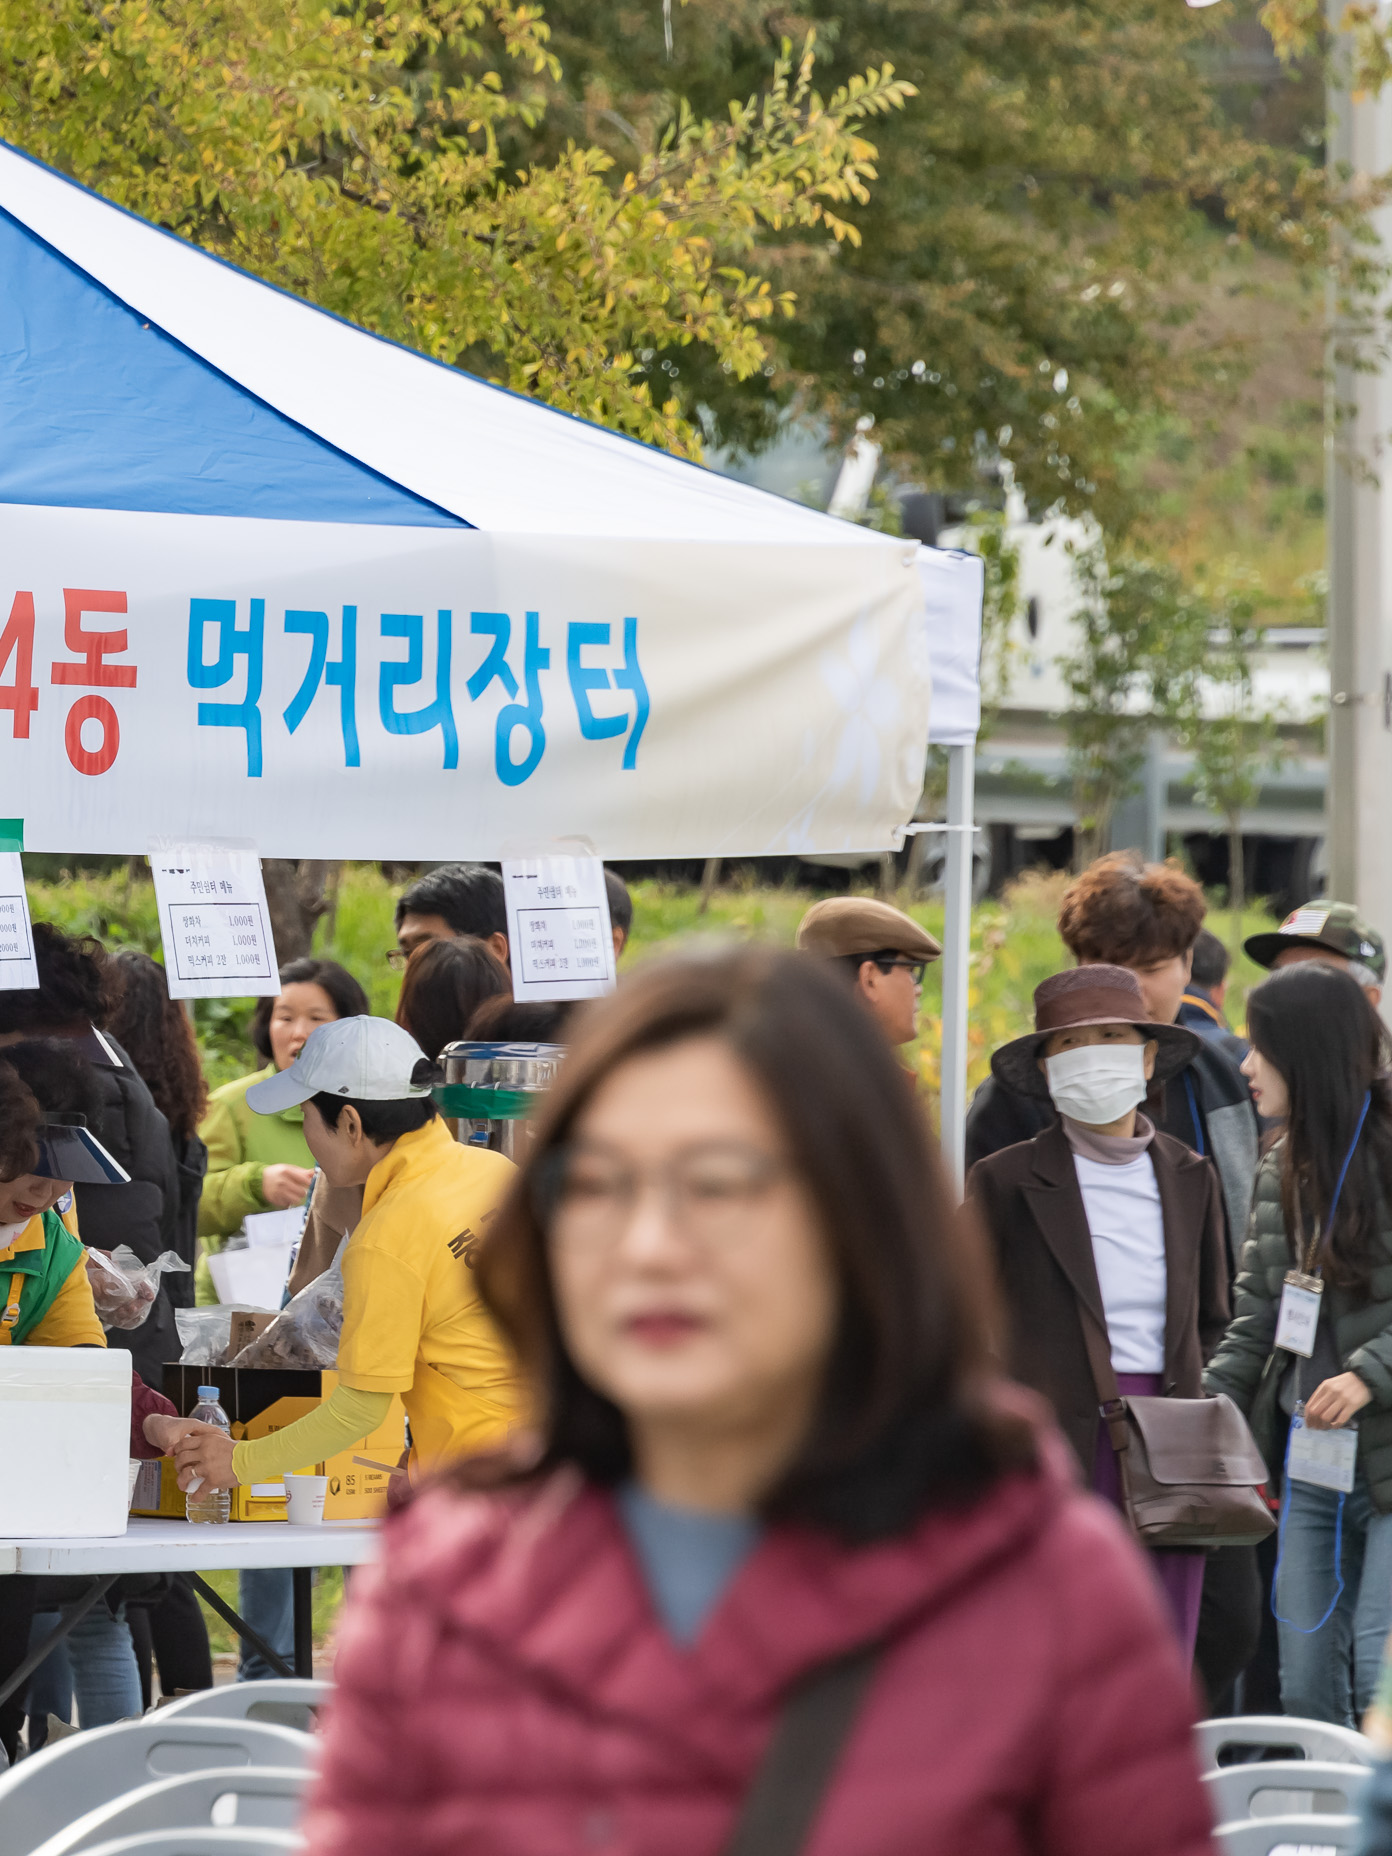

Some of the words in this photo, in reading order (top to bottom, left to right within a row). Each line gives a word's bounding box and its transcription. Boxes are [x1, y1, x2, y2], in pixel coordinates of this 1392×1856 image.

[185, 597, 651, 788] 먹거리장터
[190, 880, 217, 894] 주민쉼터
[219, 880, 233, 894] 메뉴
[185, 935, 210, 948] 더치커피
[187, 954, 214, 967] 믹스커피
[216, 954, 227, 966] 2잔
[345, 1474, 356, 1486] 85
